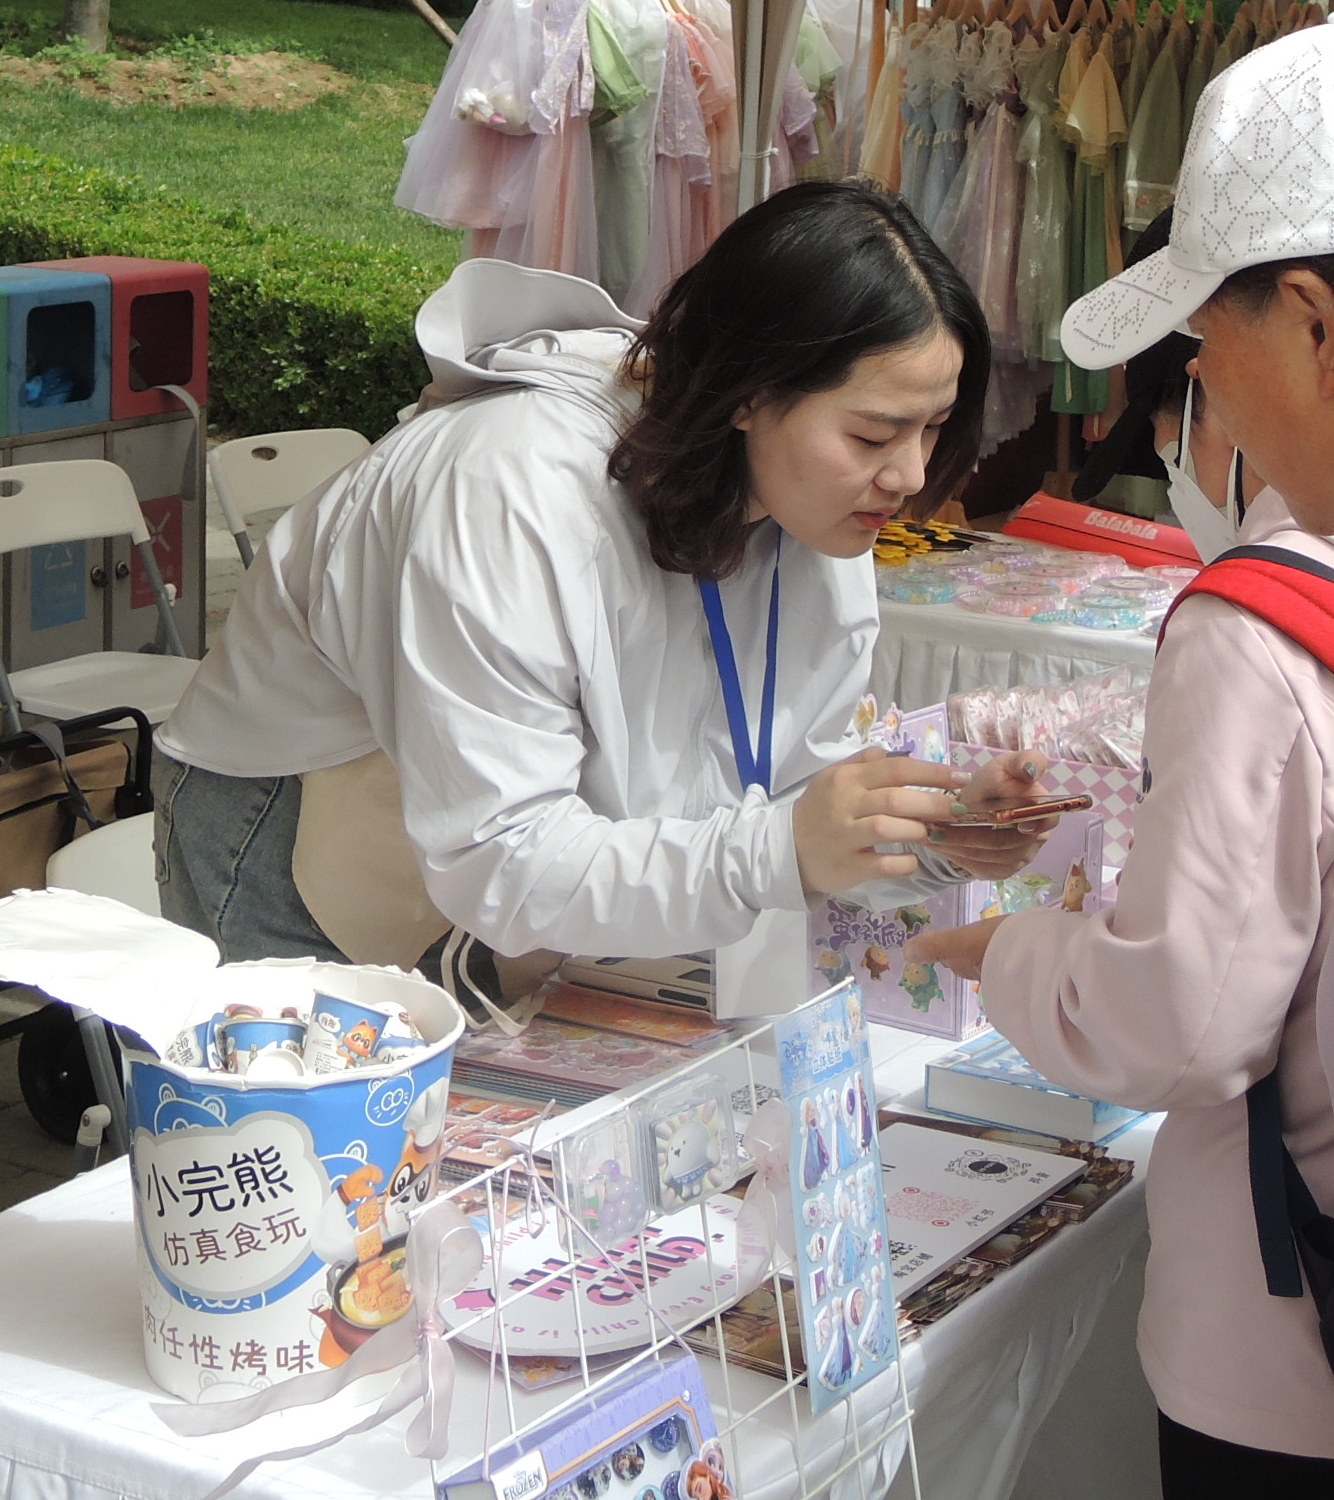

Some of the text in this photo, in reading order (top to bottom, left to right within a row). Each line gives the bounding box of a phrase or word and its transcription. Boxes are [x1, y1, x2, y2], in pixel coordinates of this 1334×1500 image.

[1084, 510, 1158, 540] Balabala
[147, 1145, 294, 1218] 小完熊
[163, 1207, 307, 1267] 仿真食玩
